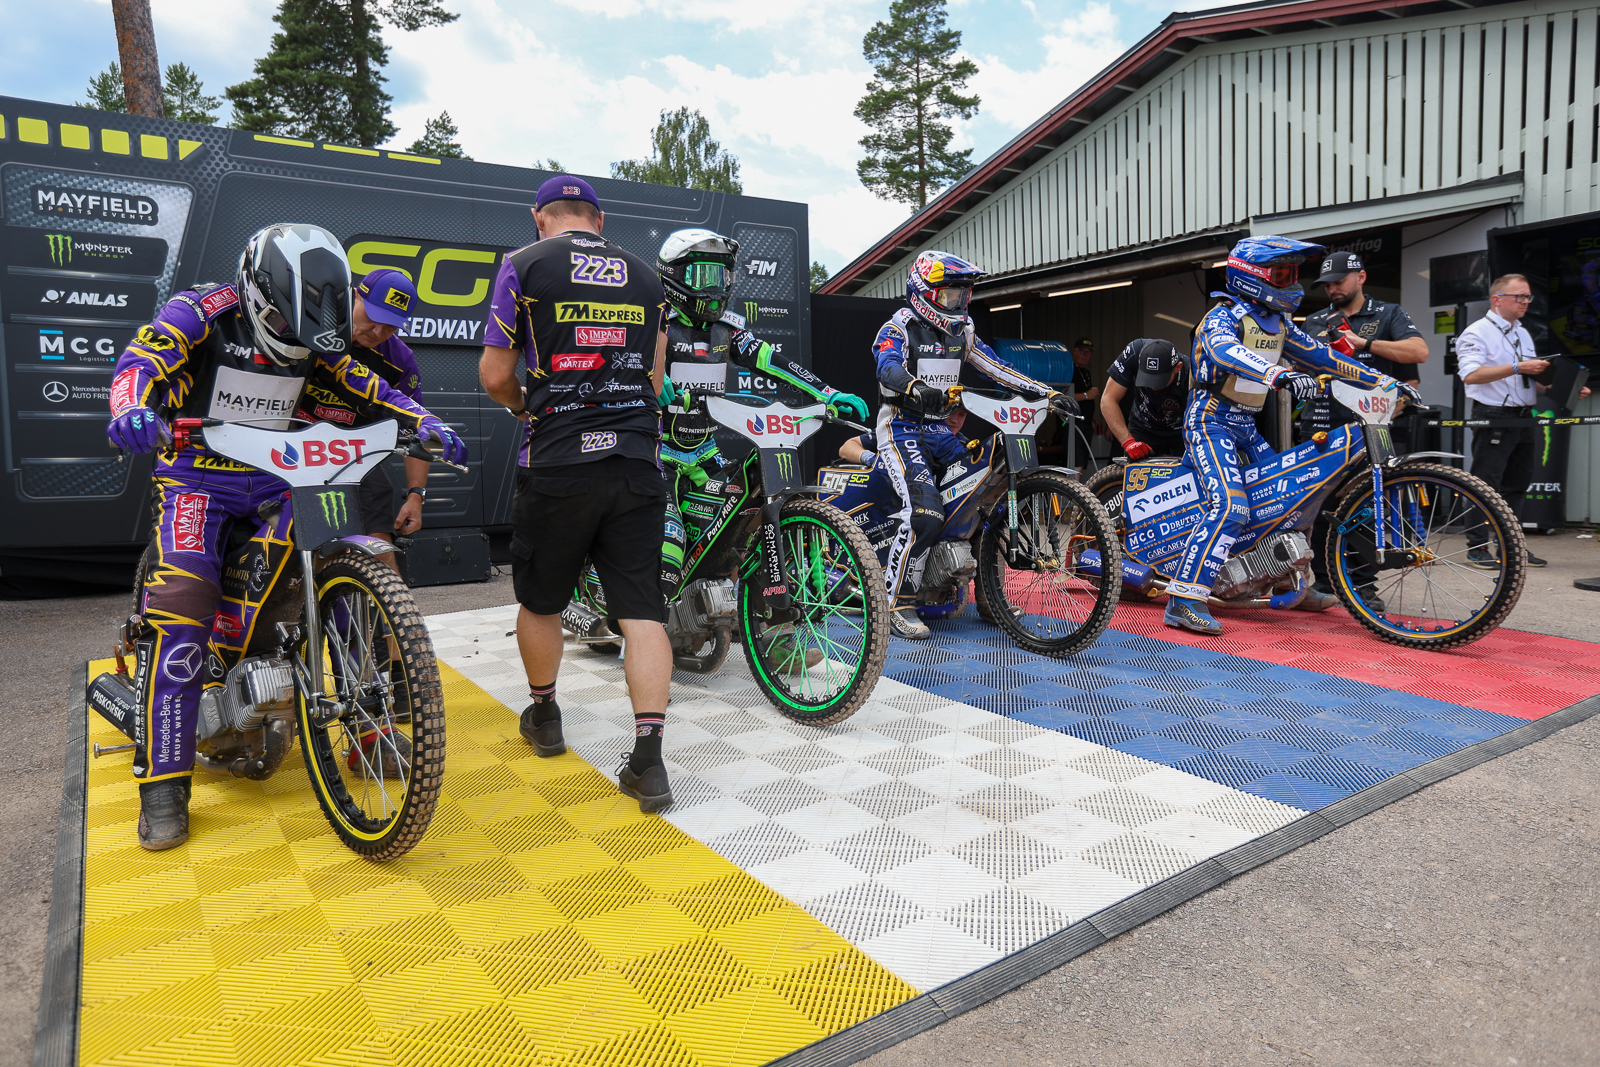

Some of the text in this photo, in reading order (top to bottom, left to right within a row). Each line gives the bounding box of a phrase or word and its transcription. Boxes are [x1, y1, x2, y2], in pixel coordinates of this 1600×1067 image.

[563, 186, 580, 195] 223
[37, 190, 153, 215] MAYFIELD
[38, 204, 153, 221] SPORTS EVENTS
[74, 242, 133, 255] MONSTER
[347, 241, 507, 307] SG
[571, 252, 628, 287] 223
[745, 259, 778, 277] FIM
[210, 289, 232, 304] IMPAKT
[1242, 284, 1258, 294] ORLEN
[66, 291, 129, 307] ANLAS
[560, 304, 643, 322] TM EXPRESS
[758, 306, 789, 314] MONSTER
[910, 293, 949, 330] Red Bull
[589, 329, 624, 339] IMPAKT
[39, 335, 115, 355] MCG
[224, 342, 252, 359] FIM
[673, 343, 693, 353] FIM
[918, 344, 934, 353] FIM
[1255, 338, 1279, 350] LEADER
[559, 360, 595, 369] MARTEX
[1245, 352, 1268, 367] ORLEN
[920, 374, 958, 383] MAYFIELD
[216, 402, 257, 415] SPORTS
[217, 390, 295, 412] MAYFIELD
[325, 409, 354, 420] IMPAKT
[1009, 406, 1037, 425] BST
[766, 415, 802, 435] BST
[581, 431, 617, 453] 223
[1298, 444, 1315, 457] ORLEN
[302, 439, 366, 467] BST
[1195, 444, 1212, 475] ORLEN
[1150, 468, 1173, 476] SGP
[1260, 461, 1278, 472] ORLEN
[822, 472, 850, 495] 505
[849, 474, 870, 483] SGP
[1126, 467, 1151, 492] 95
[1152, 482, 1192, 505] ORLEN
[1251, 484, 1277, 497] PROMET
[1252, 490, 1273, 501] CARGO
[178, 496, 195, 534] IMPAKT
[1207, 492, 1221, 521] ORLEN
[707, 495, 738, 541] Porta Mare
[1170, 512, 1201, 530] DRUTEX
[1129, 528, 1156, 548] MCG
[890, 529, 909, 578] ANLAS
[1146, 538, 1187, 561] GARCAREK
[770, 540, 781, 582] MARWIS
[1181, 544, 1199, 580] ORLEN
[1124, 566, 1144, 577] ORLEN
[763, 585, 787, 597] APRO
[1178, 603, 1211, 627] daytona
[92, 689, 126, 721] PISKORSKI
[135, 650, 148, 744] PISKORSKI
[158, 694, 173, 763] Mercedes-Benz
[174, 732, 182, 762] GRUPA
